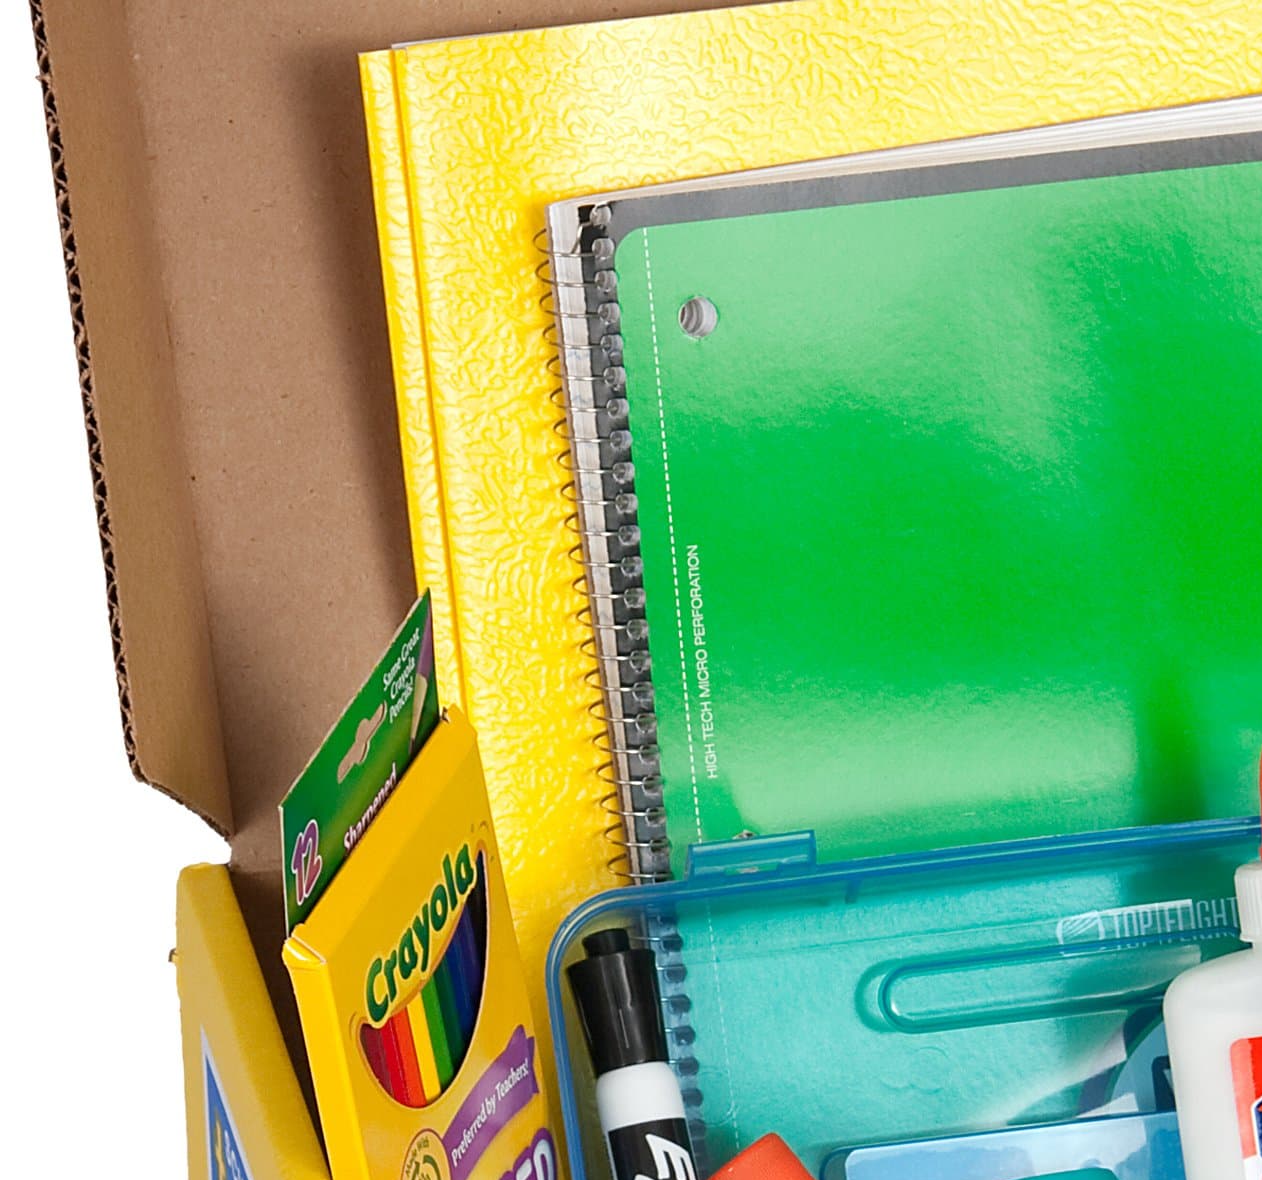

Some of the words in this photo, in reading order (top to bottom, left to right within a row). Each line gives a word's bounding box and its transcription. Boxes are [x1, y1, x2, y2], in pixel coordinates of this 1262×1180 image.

[686, 544, 706, 646] PERFORATION
[695, 648, 711, 698] MICRO
[700, 701, 715, 741] TECH
[704, 743, 718, 779] HIGH
[291, 819, 322, 906] 12
[366, 843, 474, 1023] Crayola
[450, 1109, 486, 1168] Preferred
[484, 1093, 498, 1118] by
[494, 1057, 530, 1103] Teachers!
